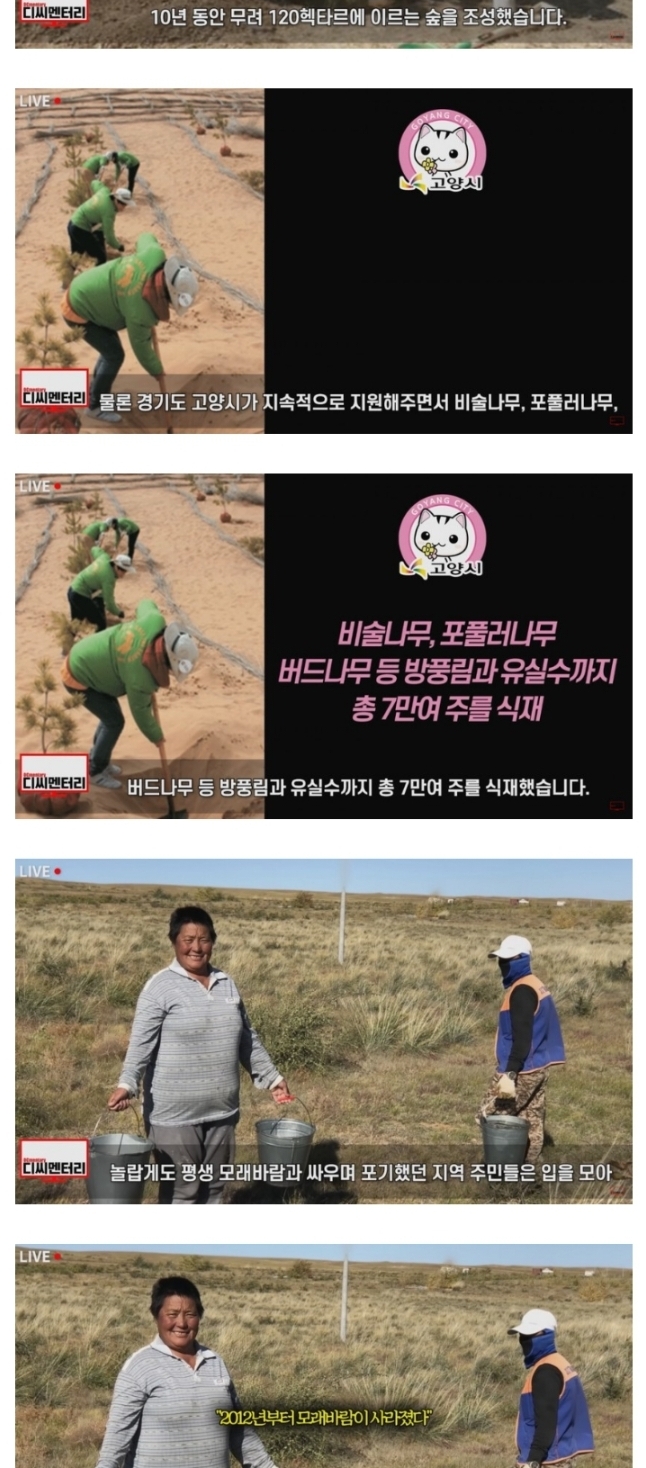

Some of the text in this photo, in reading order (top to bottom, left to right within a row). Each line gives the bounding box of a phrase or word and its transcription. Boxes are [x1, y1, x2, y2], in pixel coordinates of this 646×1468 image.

[411, 112, 474, 130] GOYANG CITY
[430, 177, 481, 190] 고양시
